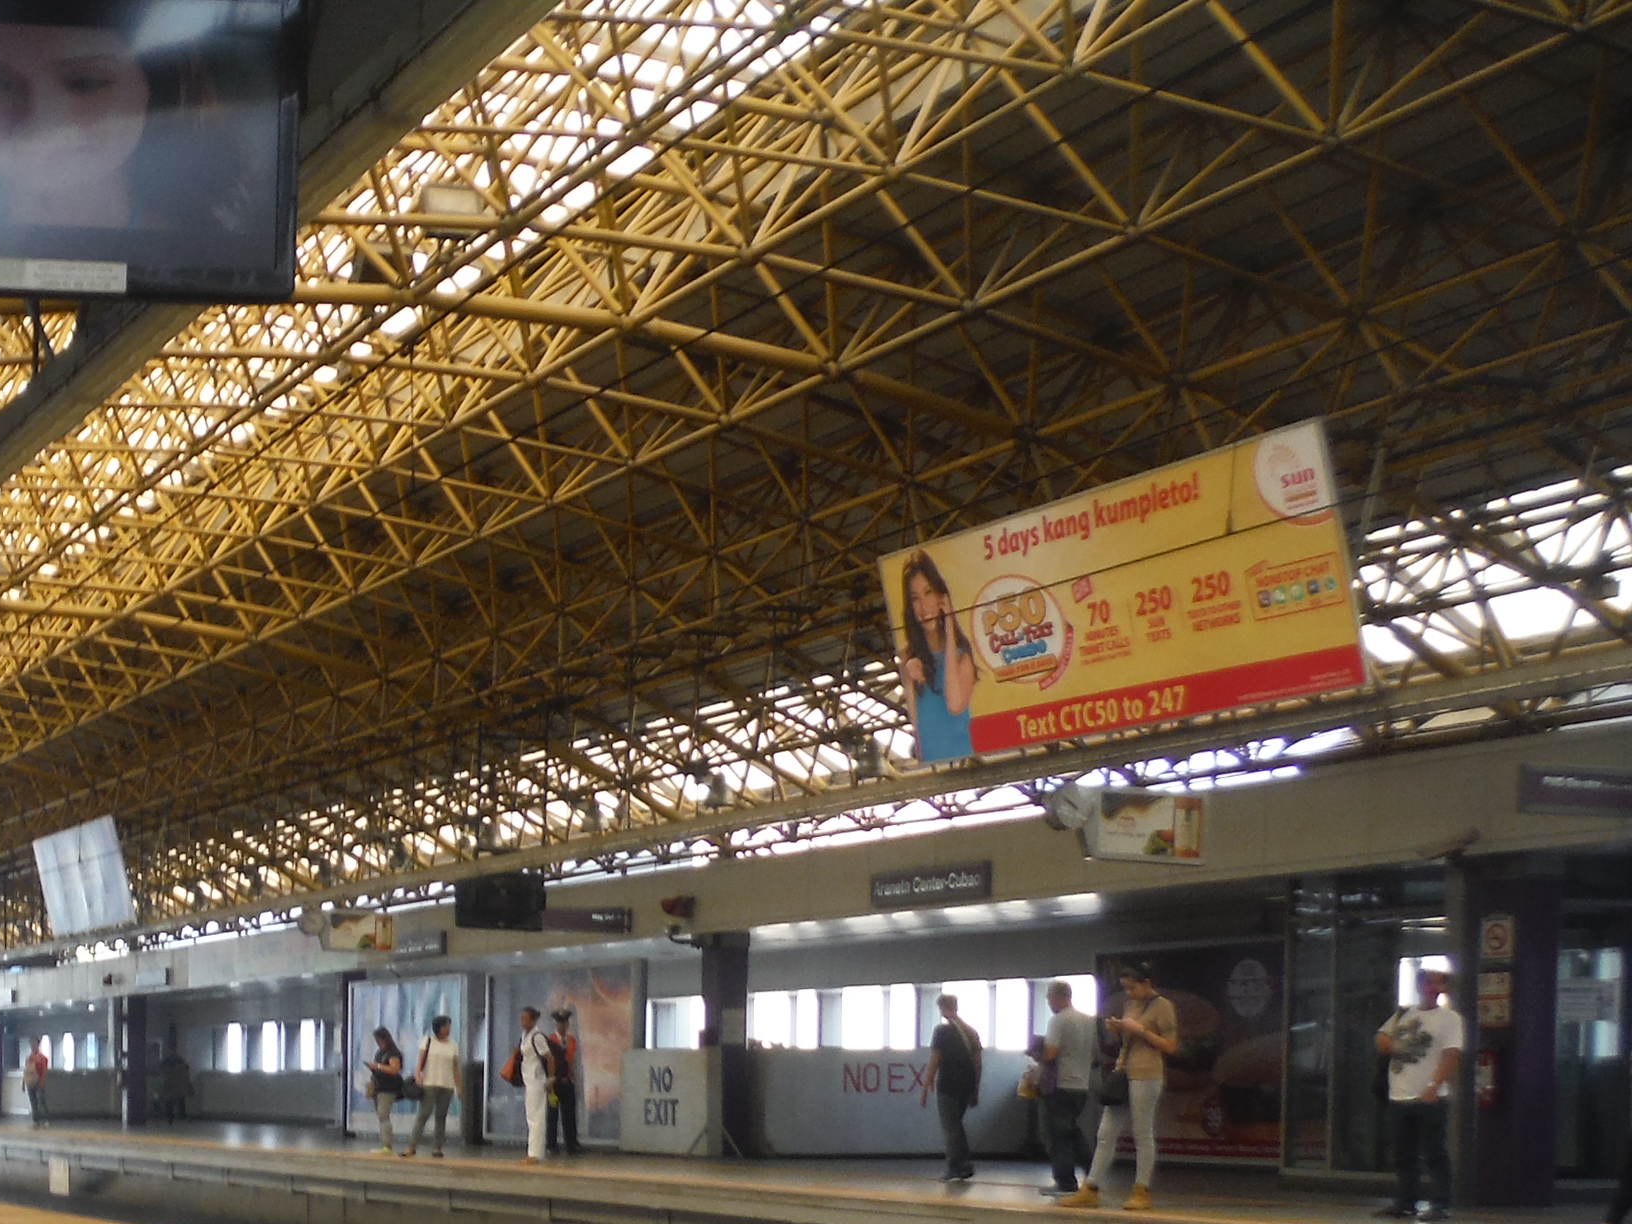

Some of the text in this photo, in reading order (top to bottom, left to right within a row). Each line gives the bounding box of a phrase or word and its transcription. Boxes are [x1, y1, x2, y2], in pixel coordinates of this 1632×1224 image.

[1280, 468, 1316, 489] sun
[983, 470, 1201, 560] 5 days kang kumpleto!
[1135, 585, 1173, 616] 250
[1190, 570, 1232, 603] 250
[1087, 599, 1111, 626] 70
[1016, 684, 1186, 739] Text CTC50 to 247
[873, 880, 911, 896] Araneta
[648, 1064, 673, 1093] NO
[842, 1062, 881, 1093] NO
[643, 1098, 679, 1127] EXIT
